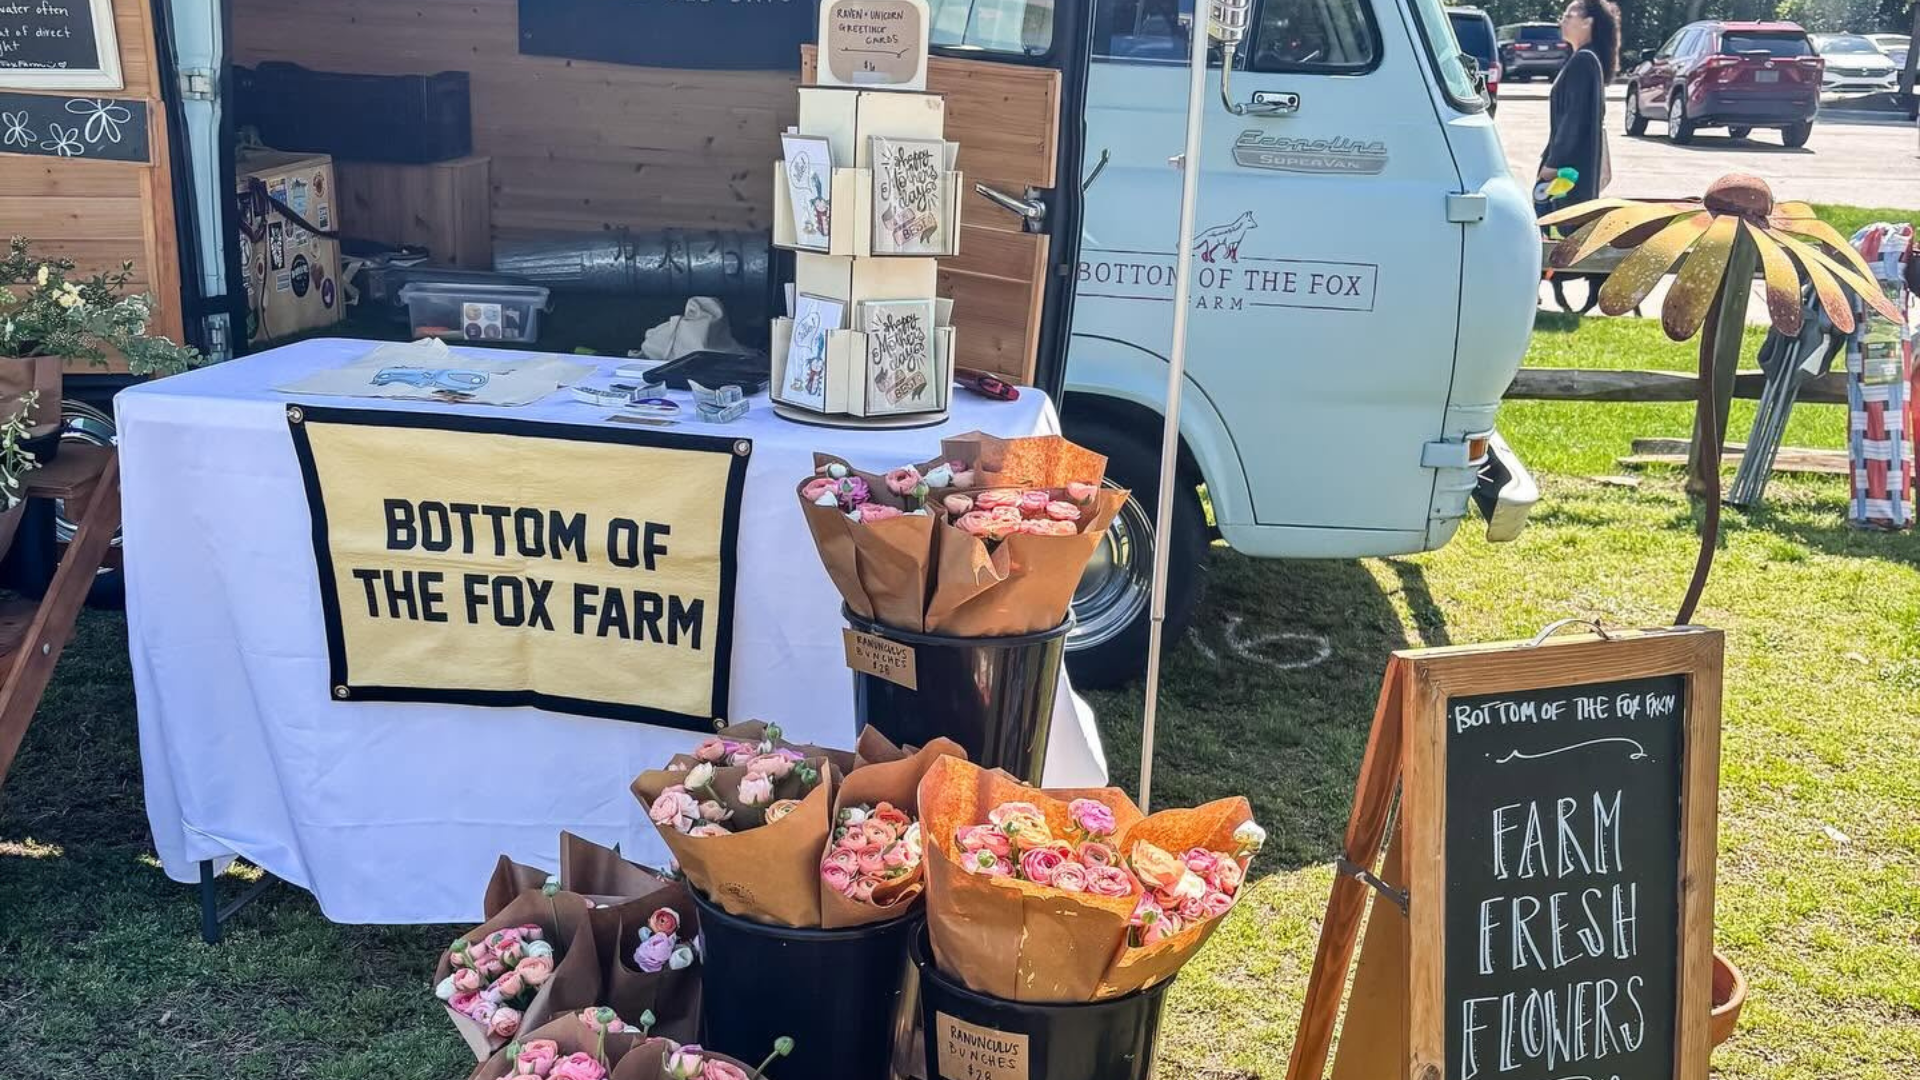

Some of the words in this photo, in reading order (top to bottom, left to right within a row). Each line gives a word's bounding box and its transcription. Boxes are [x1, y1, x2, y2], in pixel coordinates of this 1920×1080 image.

[36, 0, 69, 16] often
[836, 8, 863, 19] RAVEN
[870, 10, 904, 20] UNICORN
[15, 25, 28, 36] of
[35, 25, 71, 38] direct
[865, 34, 899, 45] CARDS
[1236, 130, 1387, 154] Econoline
[894, 147, 934, 170] happy
[1198, 267, 1233, 289] OF
[1244, 269, 1297, 293] THE
[1308, 274, 1362, 296] FOX
[1189, 295, 1243, 310] ARM
[883, 313, 920, 335] happy
[383, 498, 587, 562] BOTTOM
[607, 517, 671, 571] OF
[353, 568, 448, 622] THE
[464, 574, 555, 631] FOX
[574, 583, 705, 650] FARM
[856, 646, 907, 669] BUNCHES
[1454, 700, 1537, 734] BOTTOM
[1541, 700, 1567, 721] OF
[1573, 697, 1609, 720] THE
[1616, 693, 1641, 720] FOX
[1646, 692, 1675, 719] FARM
[1493, 789, 1623, 880] FARM
[1479, 882, 1637, 975] FRESH
[1461, 975, 1645, 1080] FLOWERS
[950, 1025, 1019, 1056] RANUNCULUS
[949, 1041, 1016, 1069] BUNCHES
[967, 1063, 992, 1080] $28
